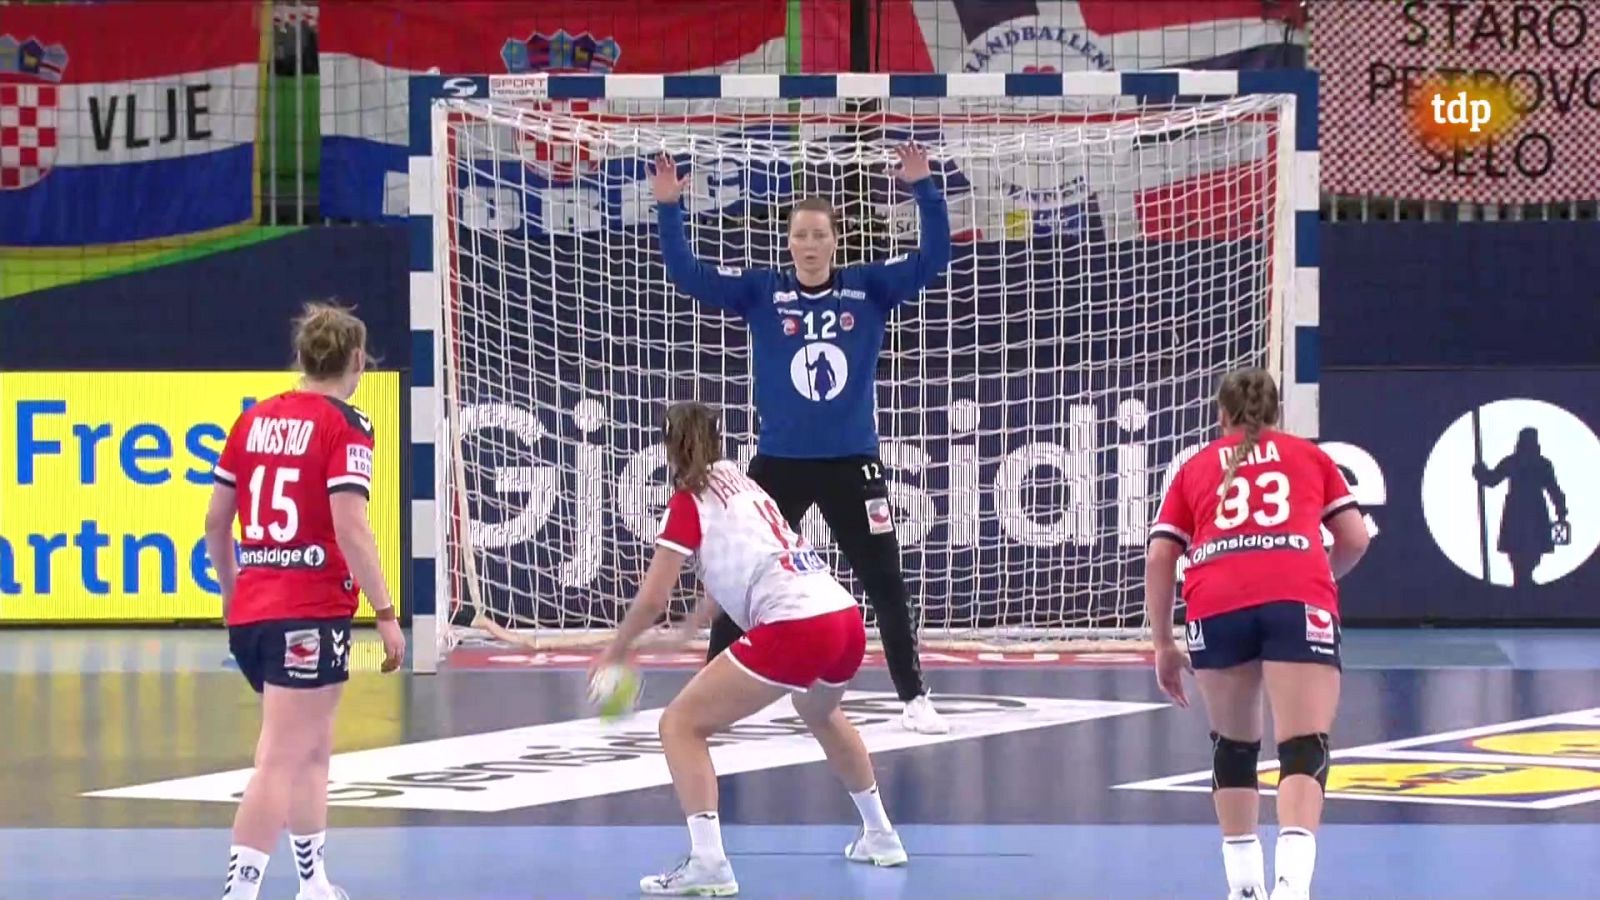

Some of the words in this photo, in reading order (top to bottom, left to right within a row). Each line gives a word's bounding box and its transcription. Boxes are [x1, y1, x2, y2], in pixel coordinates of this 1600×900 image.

[1400, 2, 1587, 49] STARO
[88, 83, 212, 151] VLJE
[803, 310, 837, 340] 12
[16, 397, 257, 486] Fres
[246, 416, 314, 456] INGSTAD
[861, 462, 882, 480] 12
[245, 465, 300, 543] 15
